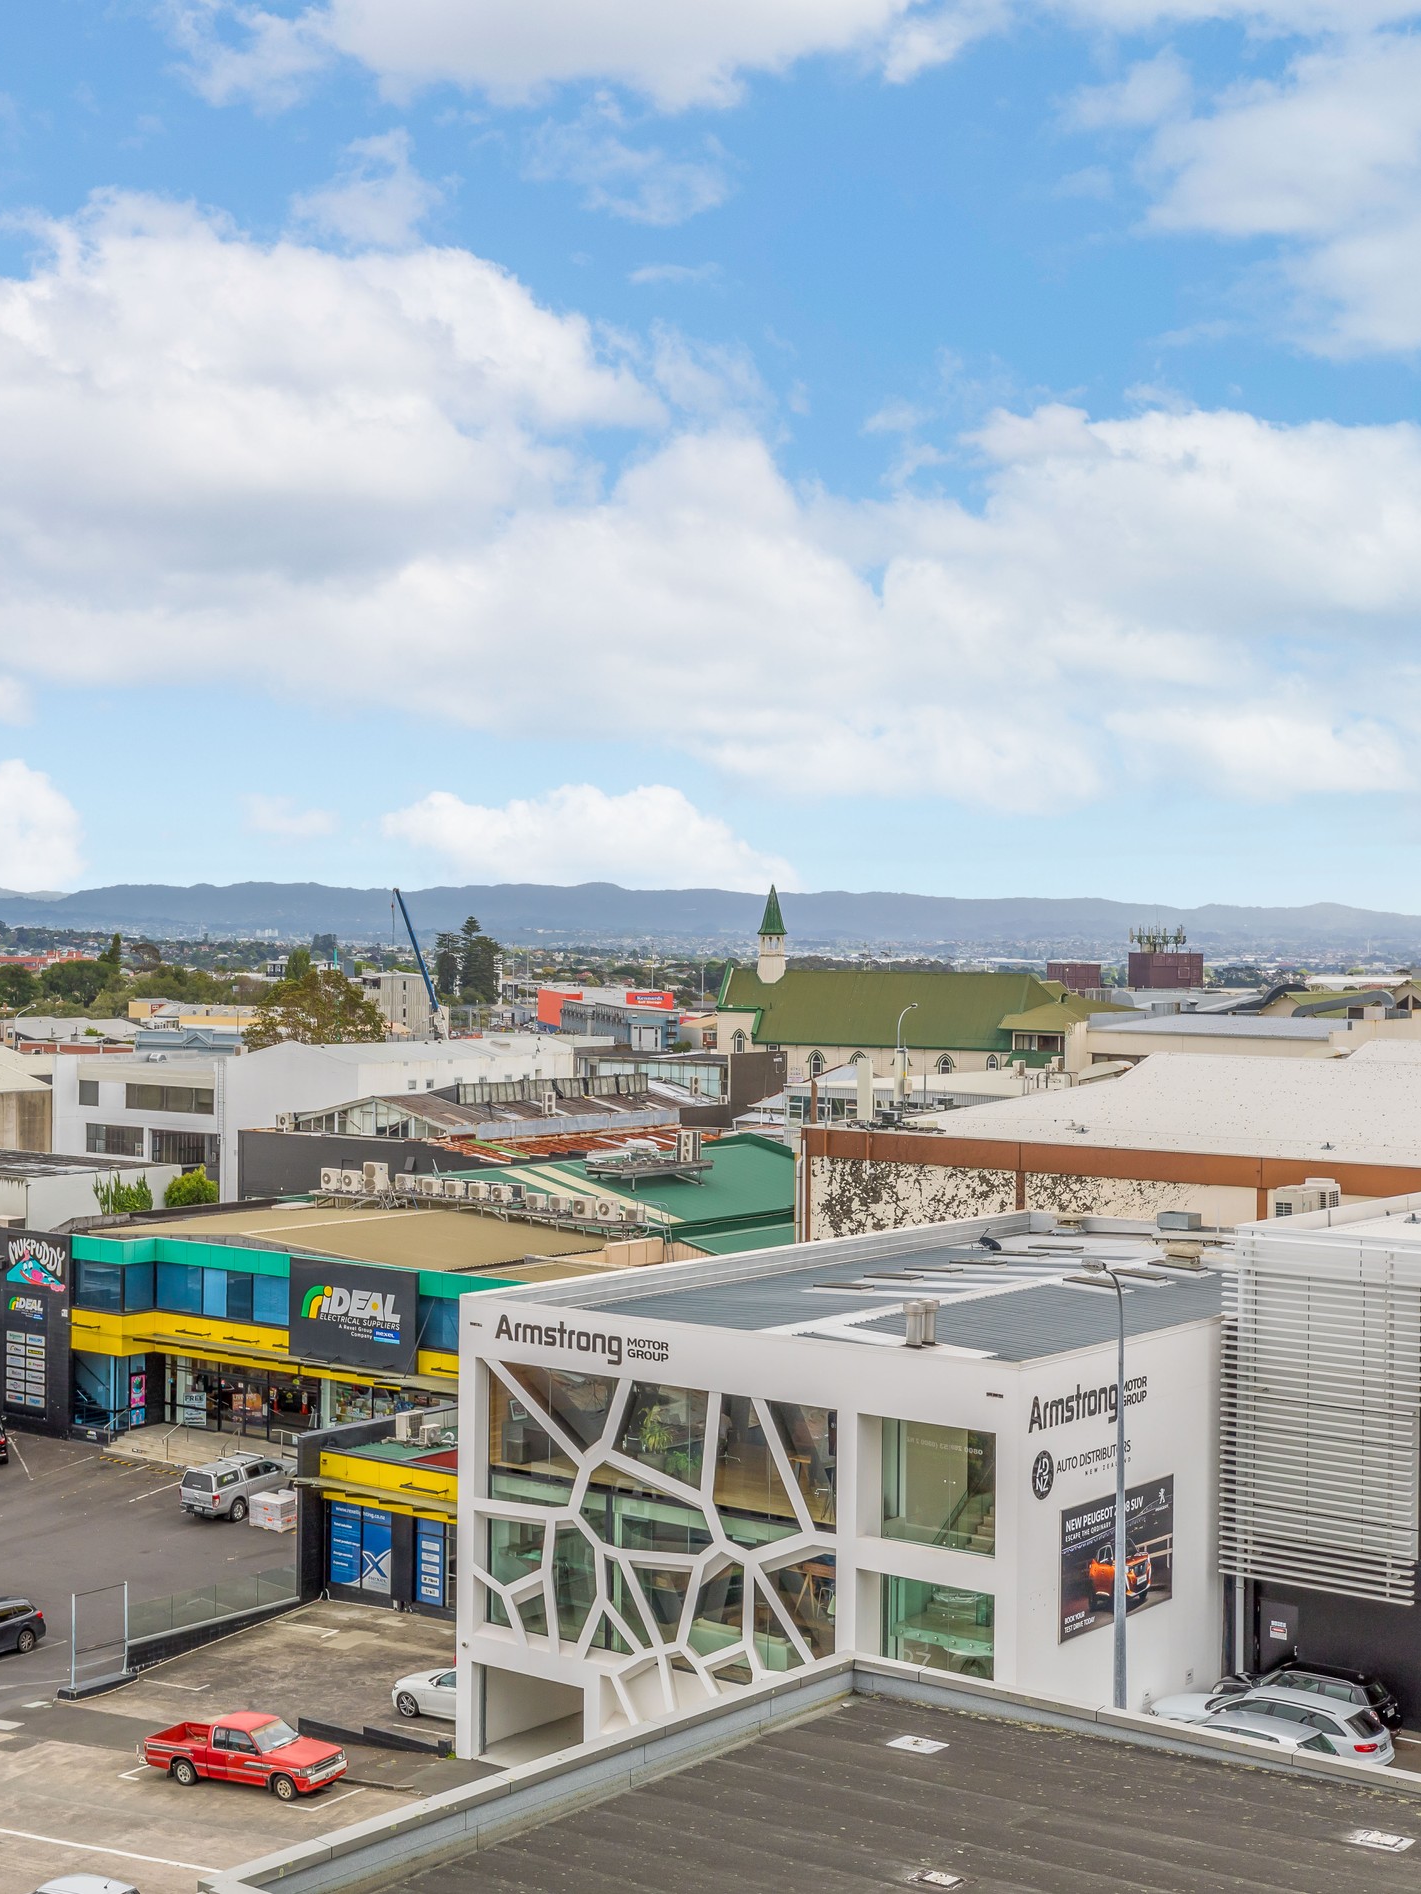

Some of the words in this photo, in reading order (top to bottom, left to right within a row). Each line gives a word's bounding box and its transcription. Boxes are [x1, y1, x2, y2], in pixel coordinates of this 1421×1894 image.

[8, 1237, 66, 1277] MUKPUDDY
[320, 1313, 360, 1326] ELECTRICAL
[362, 1319, 400, 1331] SUPPLIERS
[357, 1326, 373, 1334] Group
[350, 1331, 373, 1340] Company
[494, 1314, 622, 1366] Armstrong
[627, 1337, 669, 1352] MOTOR
[627, 1349, 669, 1363] GROUP
[1028, 1384, 1119, 1434] Armstrong
[1056, 1456, 1078, 1474] AUTO
[1079, 1440, 1131, 1467] DISTRIBUTRS
[1085, 1467, 1098, 1476] NEW
[1065, 1515, 1082, 1533] NEW
[1082, 1505, 1114, 1527] PEUGEOT
[1130, 1495, 1144, 1511] SUV
[1065, 1531, 1081, 1542] ESCAPE
[1081, 1527, 1090, 1537] THE
[1090, 1521, 1112, 1533] ORDINARY
[1064, 1614, 1075, 1625] BOOK
[1075, 1610, 1086, 1622] YOUR
[1064, 1625, 1073, 1634] TEST
[1073, 1620, 1084, 1631] DRIVE
[1083, 1616, 1096, 1626] TODAY
